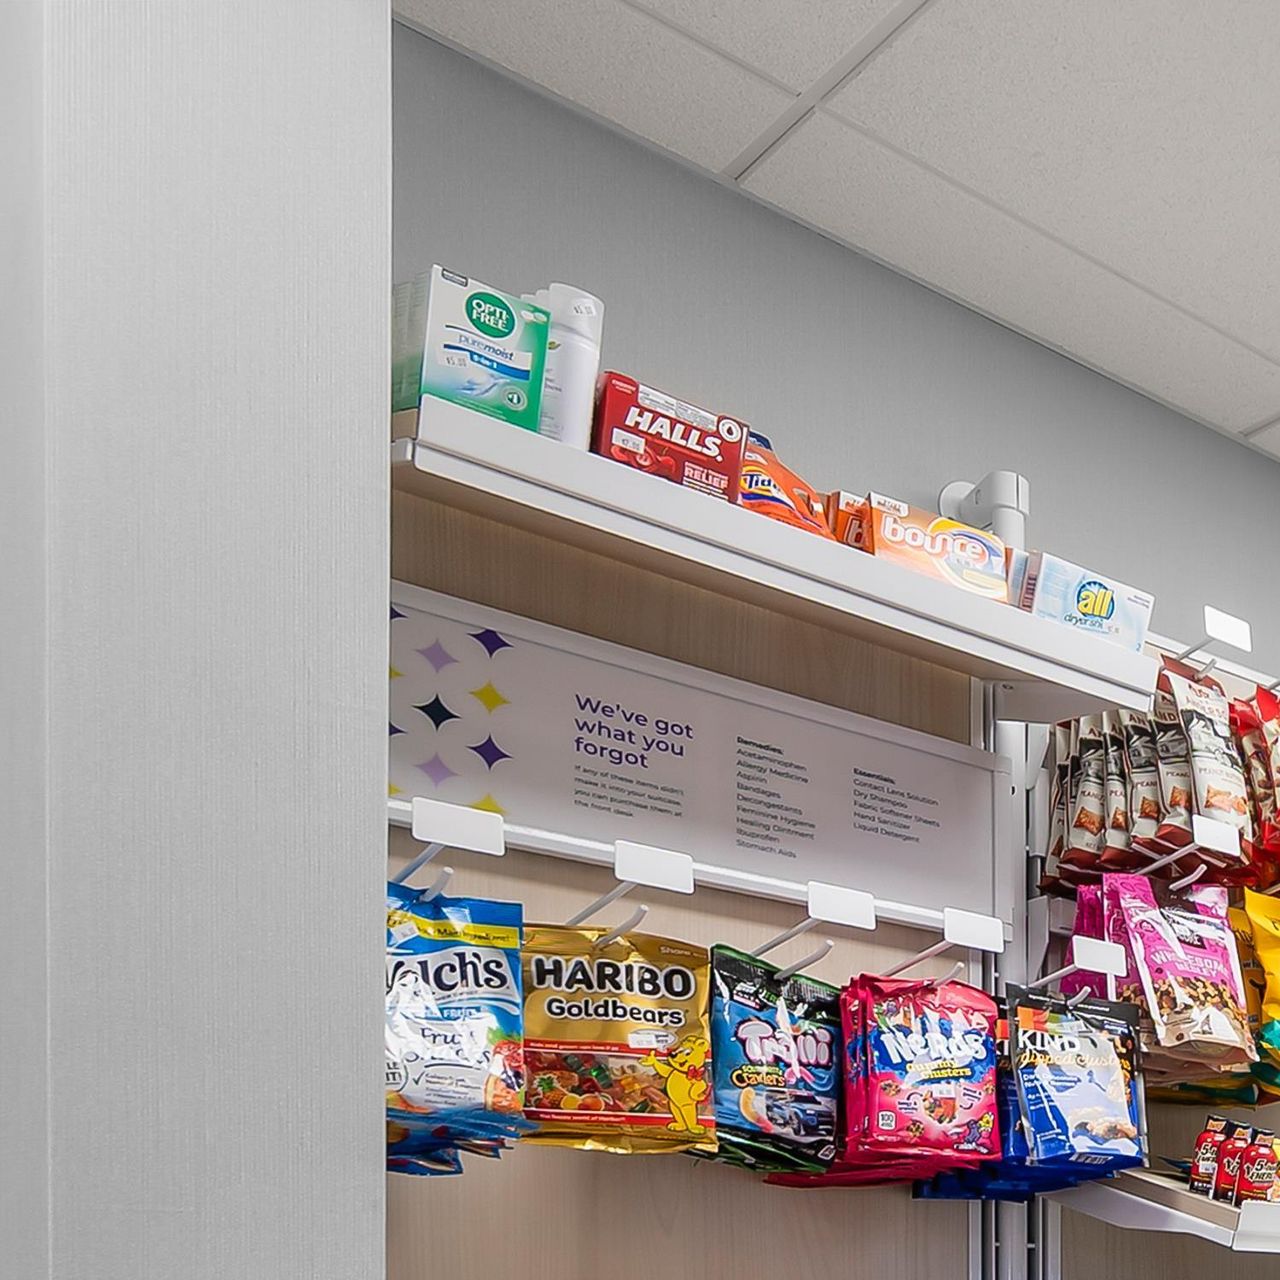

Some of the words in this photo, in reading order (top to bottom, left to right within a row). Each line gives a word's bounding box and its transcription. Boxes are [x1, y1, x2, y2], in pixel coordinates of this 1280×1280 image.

[472, 311, 508, 331] FREE
[458, 334, 514, 361] puremoist
[684, 468, 729, 490] RELIEF
[882, 515, 989, 565] bounce
[1078, 588, 1113, 621] all
[576, 694, 648, 726] We've
[655, 719, 694, 739] got
[575, 718, 636, 745] what
[642, 735, 684, 757] you
[575, 737, 648, 768] forgot
[534, 958, 692, 998] HARIBO
[546, 998, 684, 1026] Goldbears
[1017, 1030, 1080, 1052] KIND
[732, 1070, 786, 1087] Crawlers
